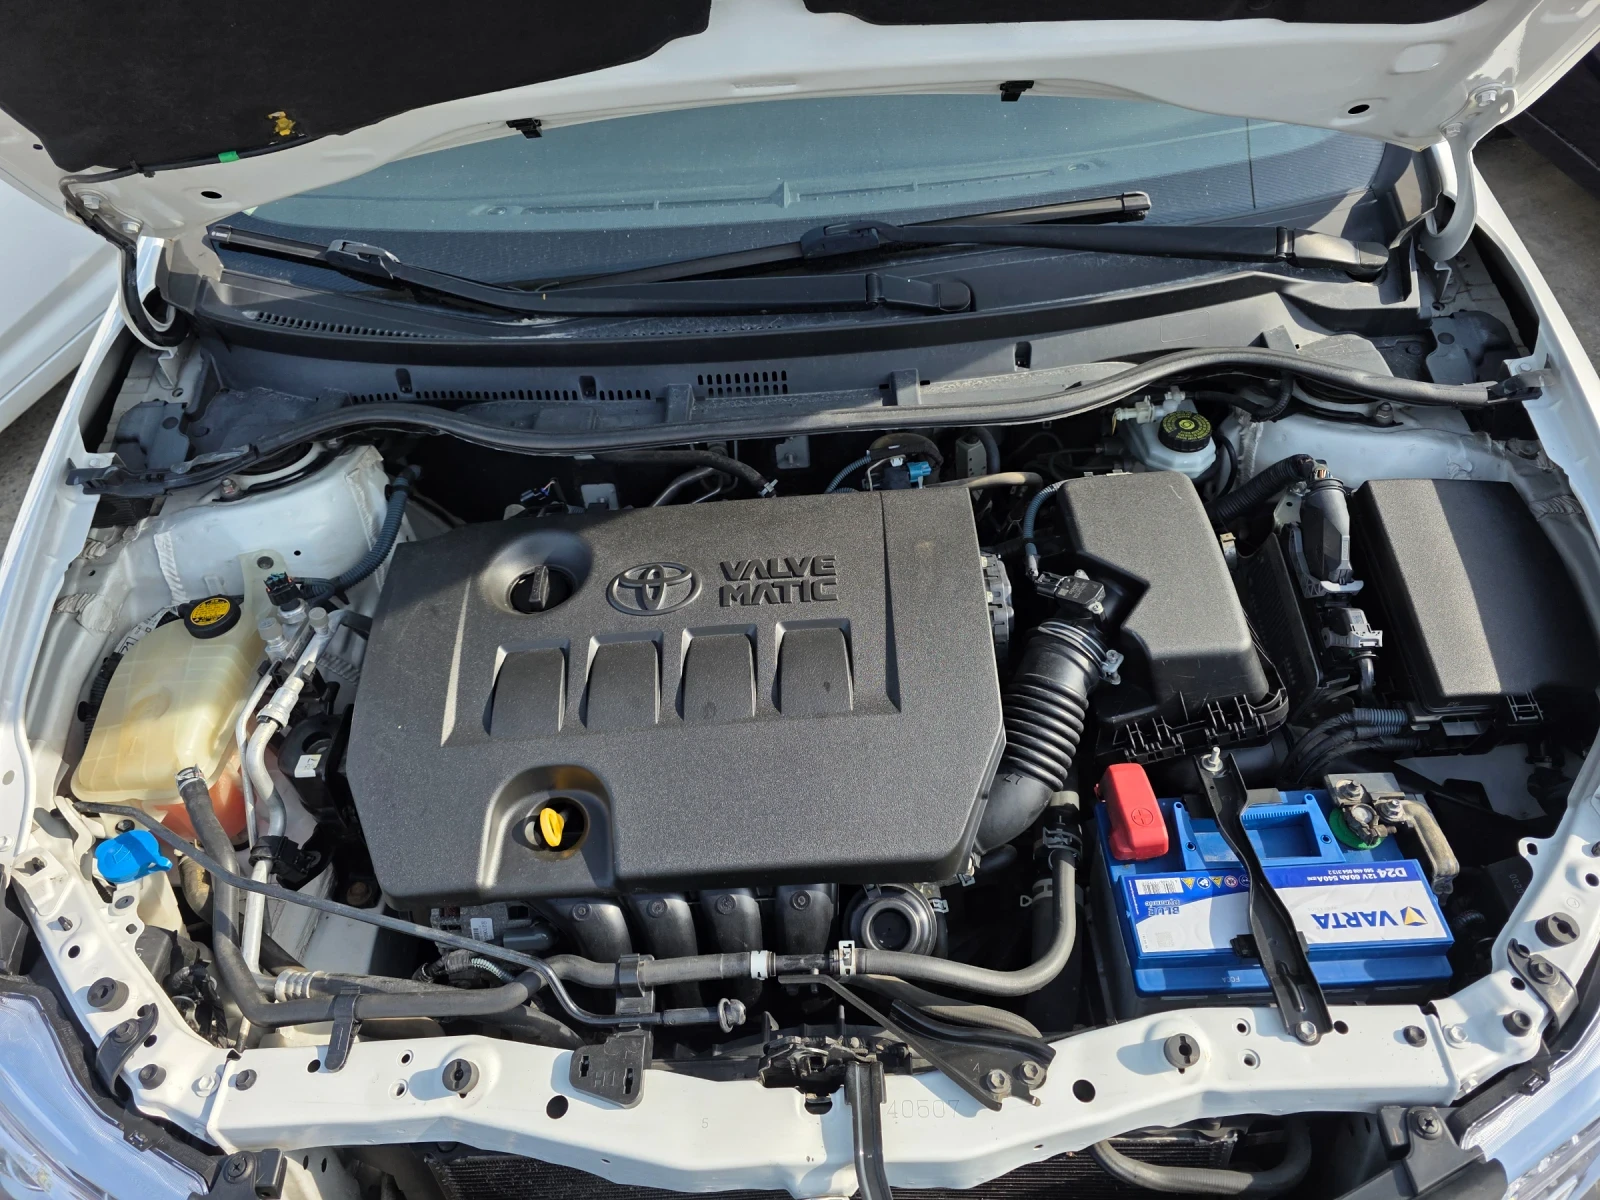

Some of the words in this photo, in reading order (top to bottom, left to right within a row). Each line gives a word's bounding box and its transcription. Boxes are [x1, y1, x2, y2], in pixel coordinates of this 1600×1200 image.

[719, 555, 837, 581] VALVE
[718, 578, 839, 608] MATIC
[1377, 867, 1408, 878] D24
[1148, 906, 1180, 916] BLUE
[1310, 910, 1399, 929] VARTA
[885, 1099, 961, 1119] 40507
